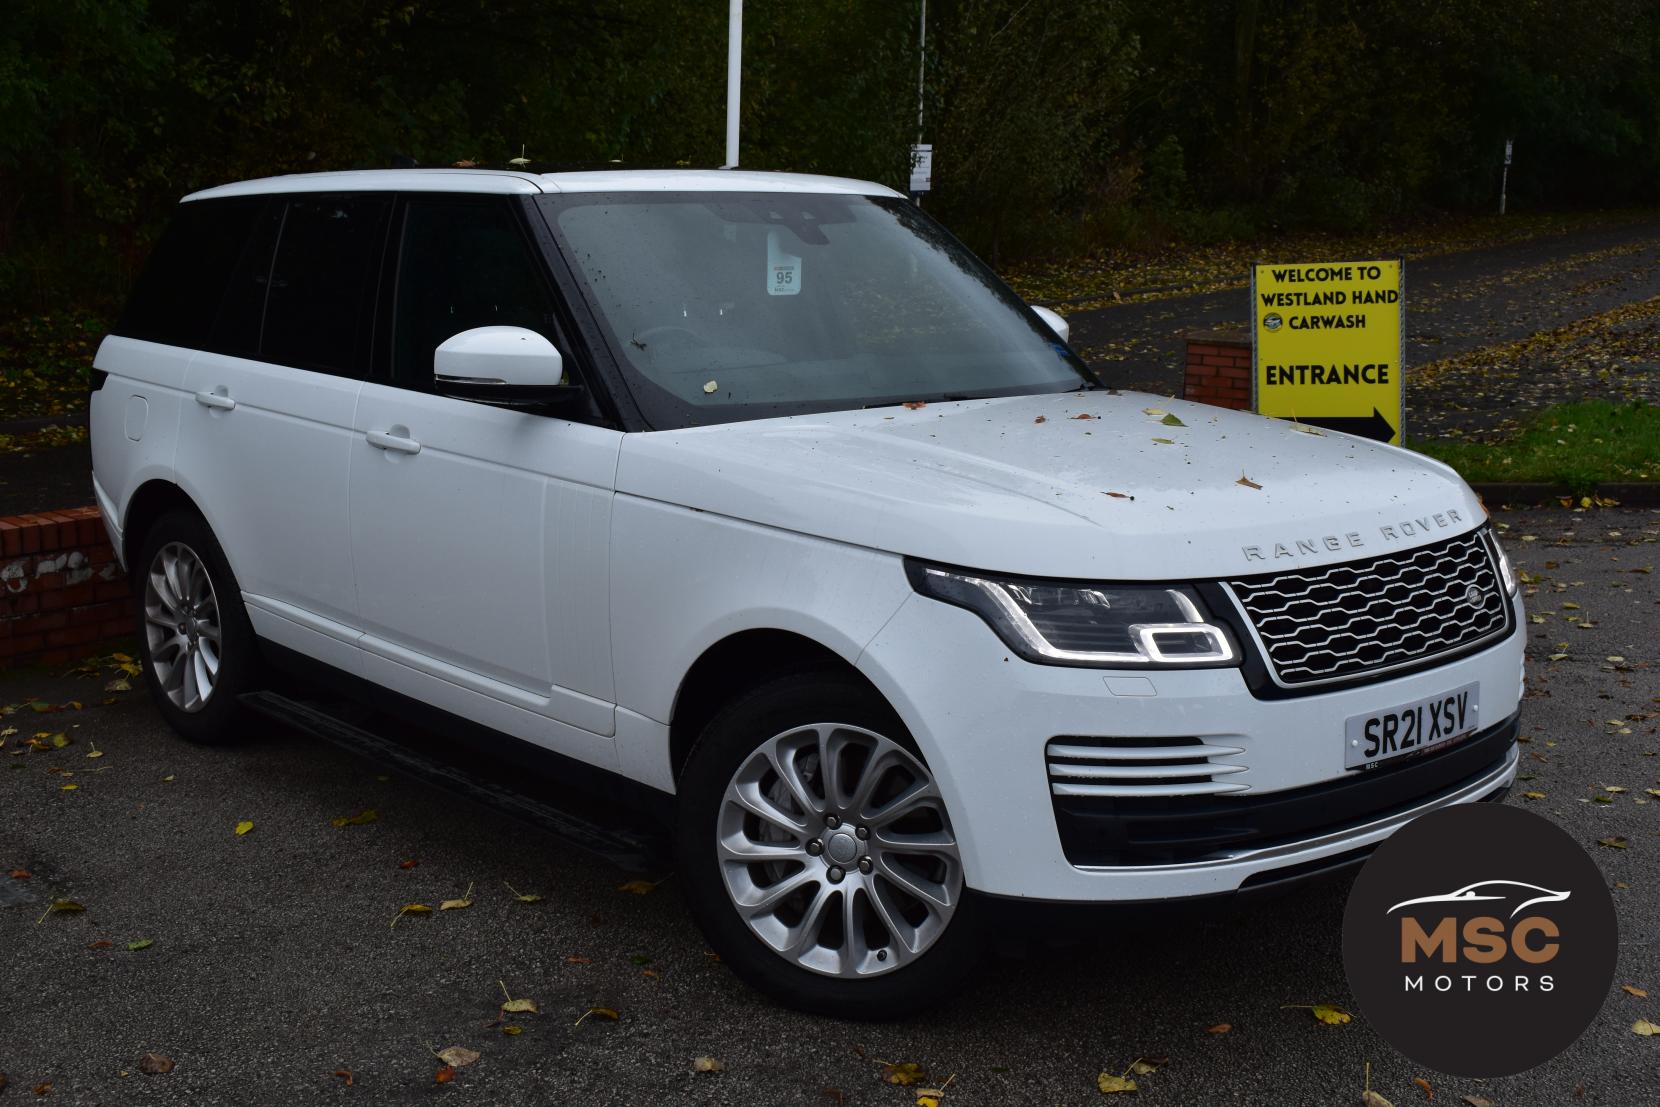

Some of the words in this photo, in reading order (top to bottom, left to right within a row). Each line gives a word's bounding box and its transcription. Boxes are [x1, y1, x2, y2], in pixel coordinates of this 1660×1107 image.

[776, 271, 792, 284] 95
[1272, 267, 1352, 282] WELCOME
[1357, 266, 1381, 280] TO
[1261, 291, 1346, 306] WESTLAND
[1352, 290, 1399, 304] HAND
[1289, 315, 1366, 330] CARWASH
[1266, 364, 1389, 385] ENTRANCE
[1242, 532, 1364, 562] RANGE
[1379, 508, 1462, 541] ROVER
[1364, 706, 1423, 758] SR21
[1428, 691, 1468, 741] XSV
